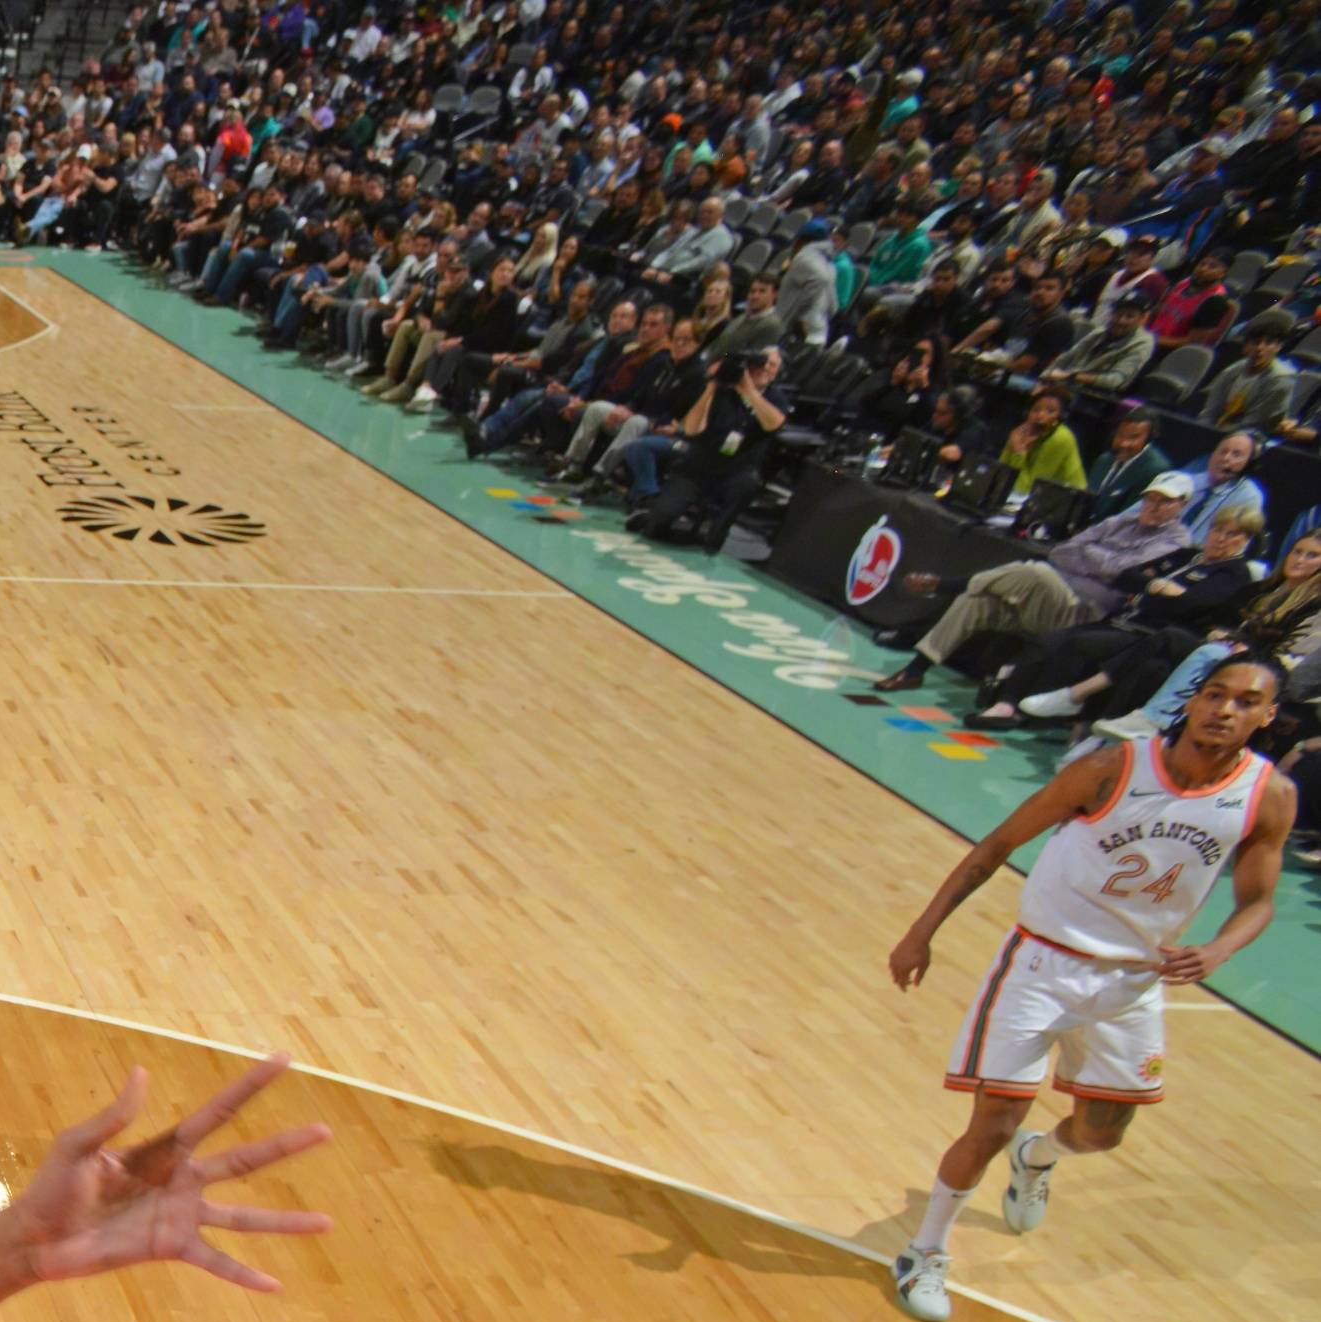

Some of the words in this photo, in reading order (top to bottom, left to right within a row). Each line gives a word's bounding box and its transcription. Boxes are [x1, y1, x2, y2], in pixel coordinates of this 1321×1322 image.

[9, 436, 127, 489] Frost
[70, 404, 182, 477] CENTER
[1098, 824, 1143, 855] SAN
[1149, 820, 1222, 867] ANTONIO
[1100, 853, 1185, 904] 24
